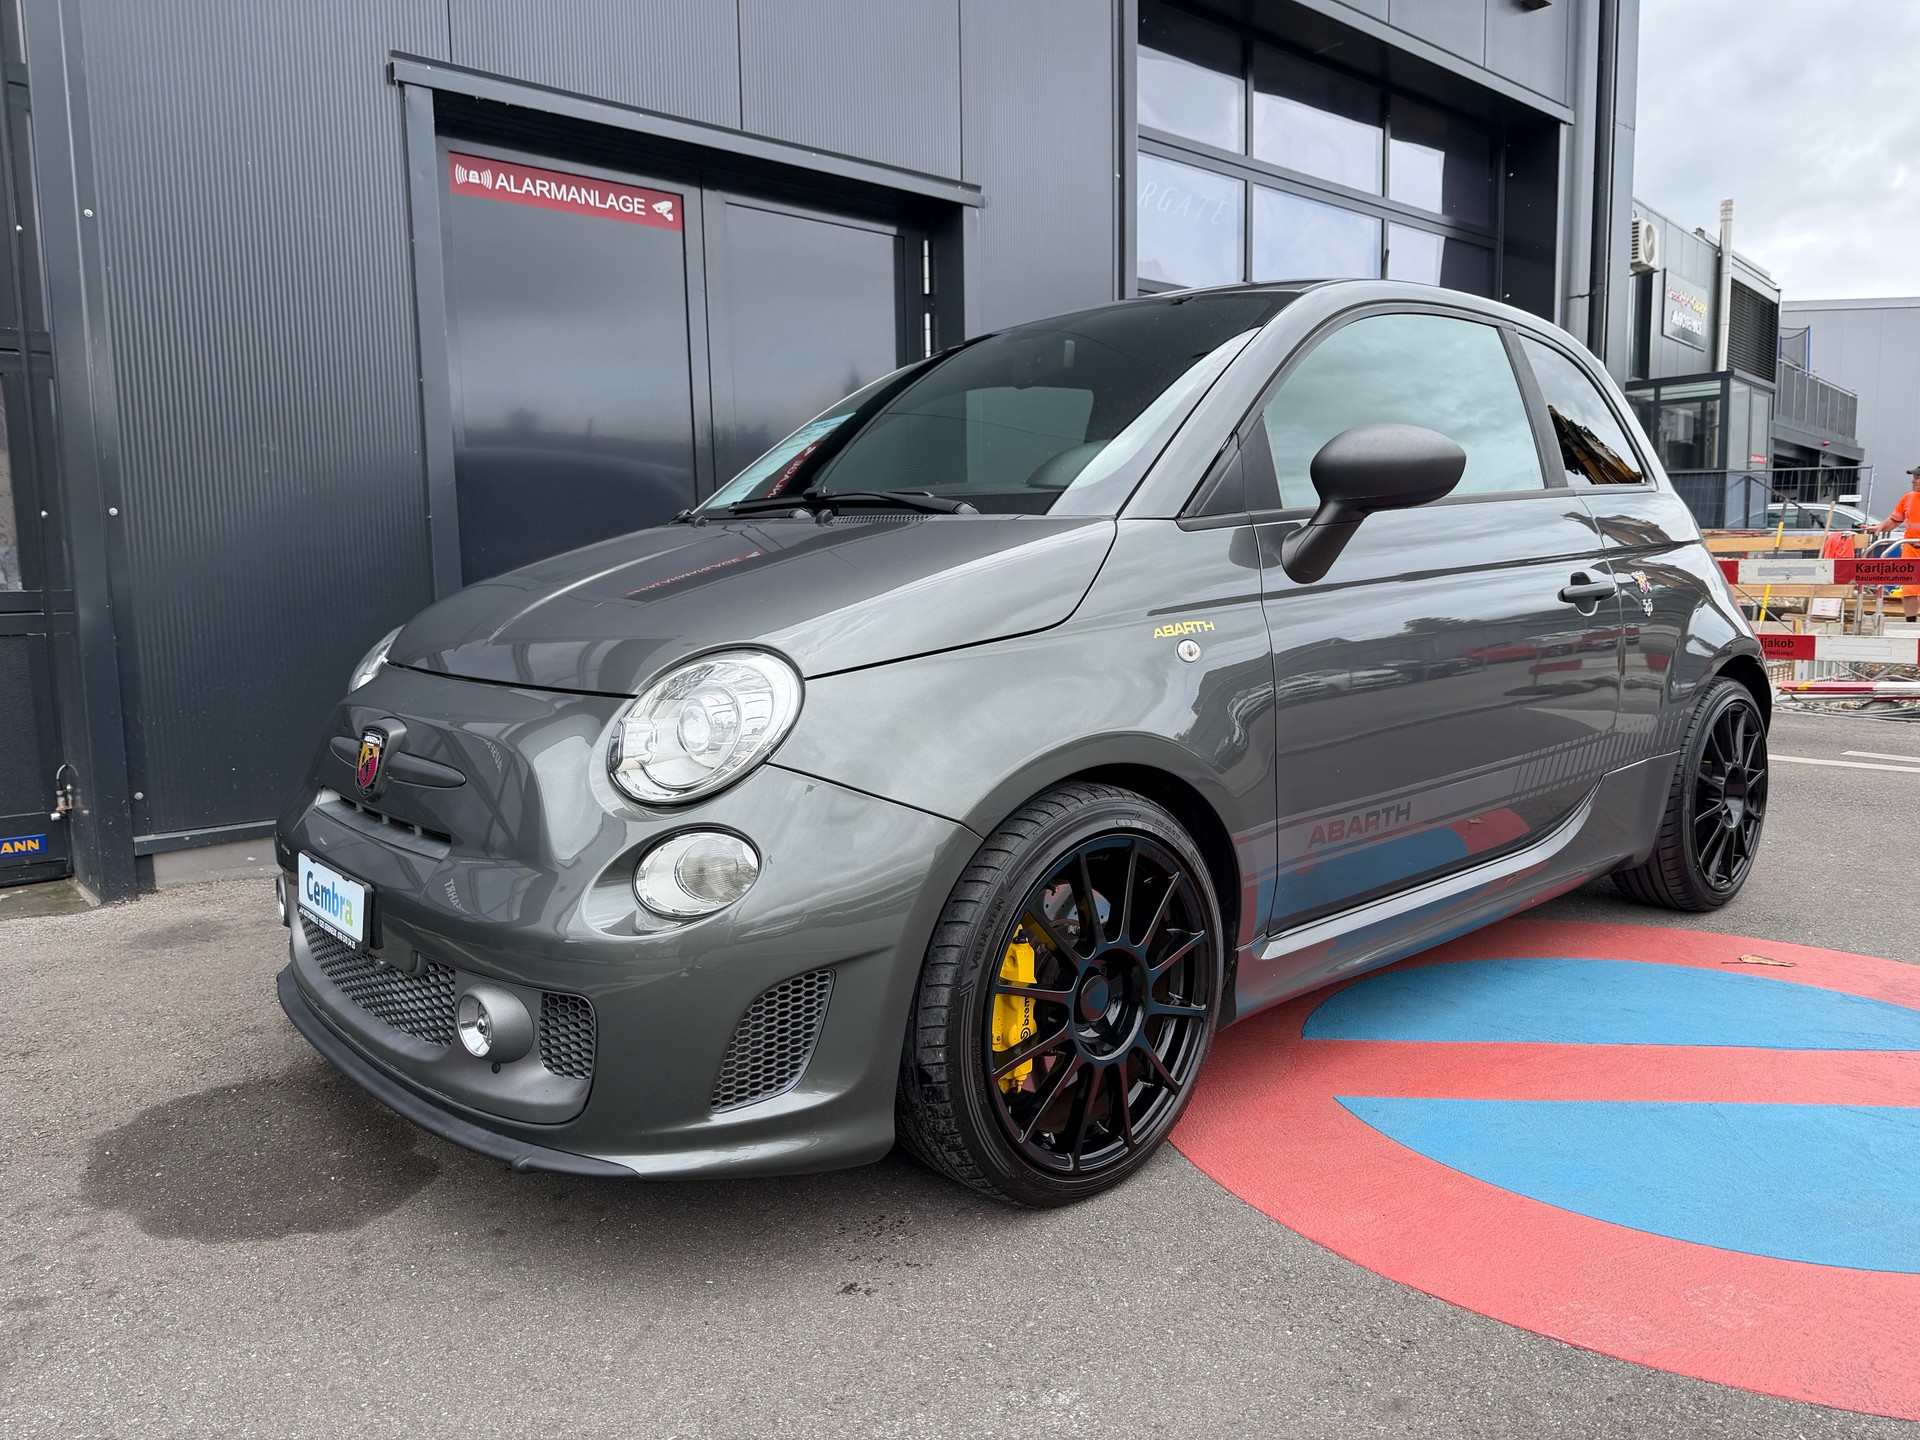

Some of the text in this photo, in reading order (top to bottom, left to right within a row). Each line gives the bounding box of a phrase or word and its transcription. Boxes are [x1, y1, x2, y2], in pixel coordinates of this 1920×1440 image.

[495, 172, 647, 216] ALARMANLAGE
[1153, 621, 1216, 639] ABARTH
[0, 839, 40, 854] ANN
[1307, 801, 1412, 849] ABARTH
[306, 870, 353, 927] Cembra
